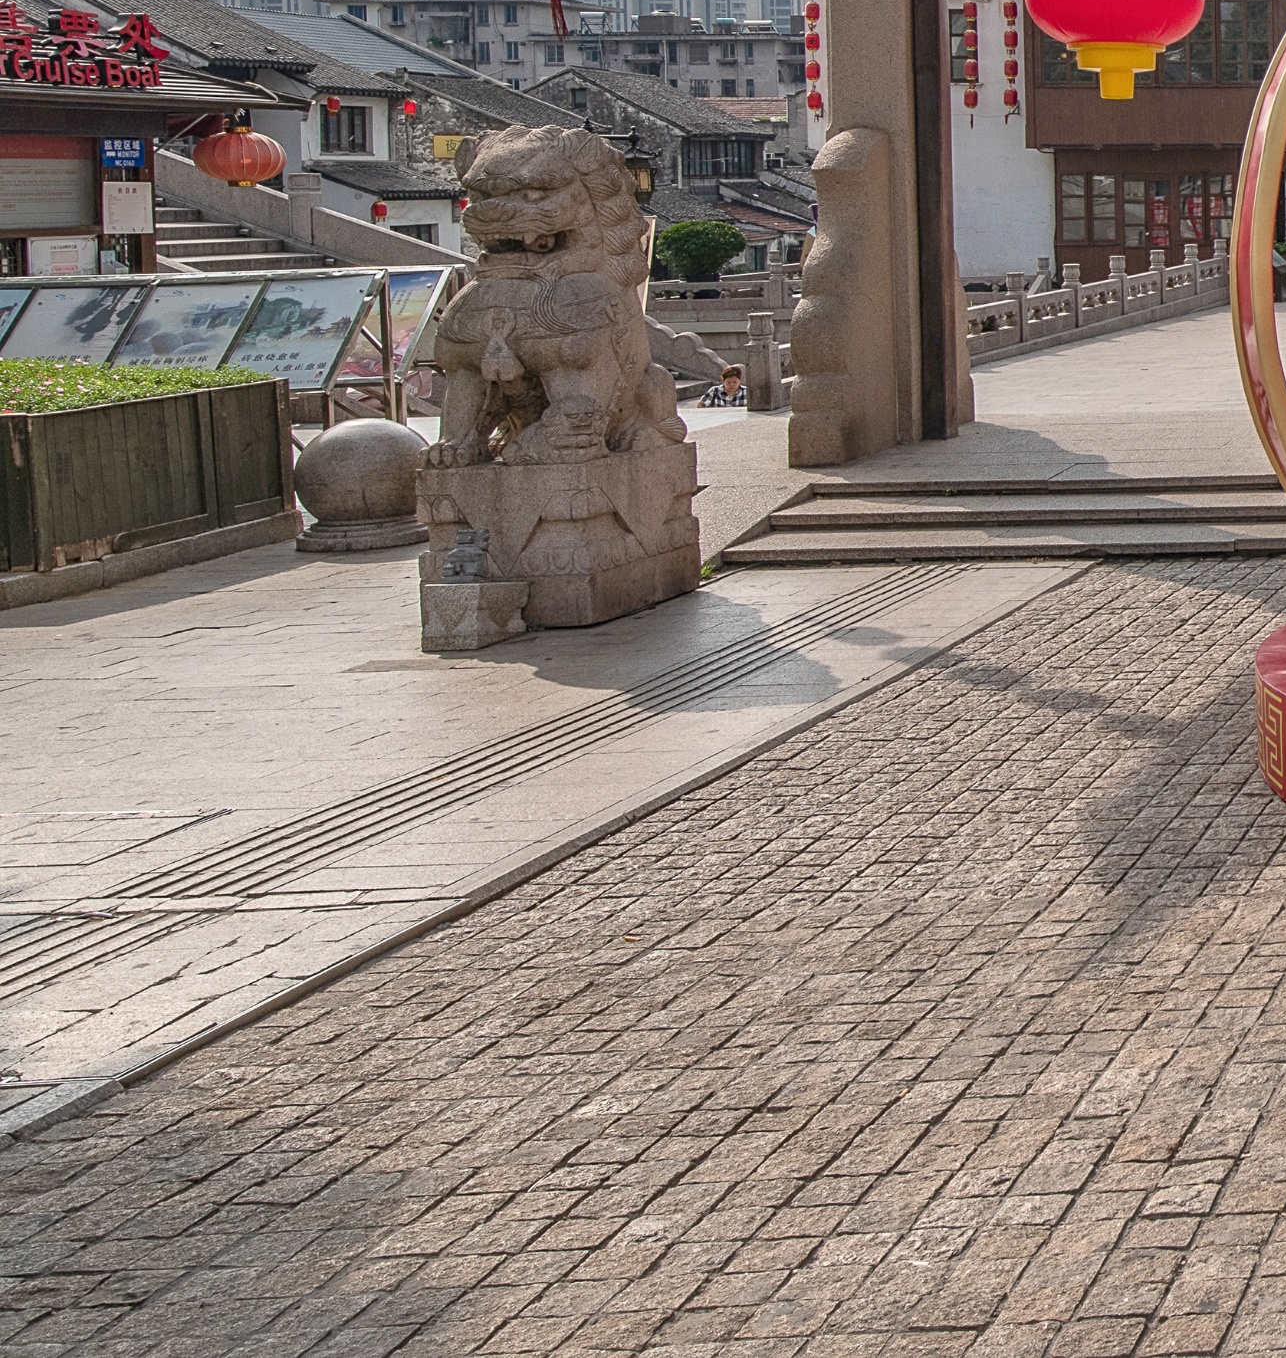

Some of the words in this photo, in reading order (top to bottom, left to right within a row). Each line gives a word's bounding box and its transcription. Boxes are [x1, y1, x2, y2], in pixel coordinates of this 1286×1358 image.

[12, 44, 101, 86] Cruise
[104, 58, 163, 87] Boat
[104, 140, 141, 150] 监控区域
[117, 150, 140, 158] MONITOR
